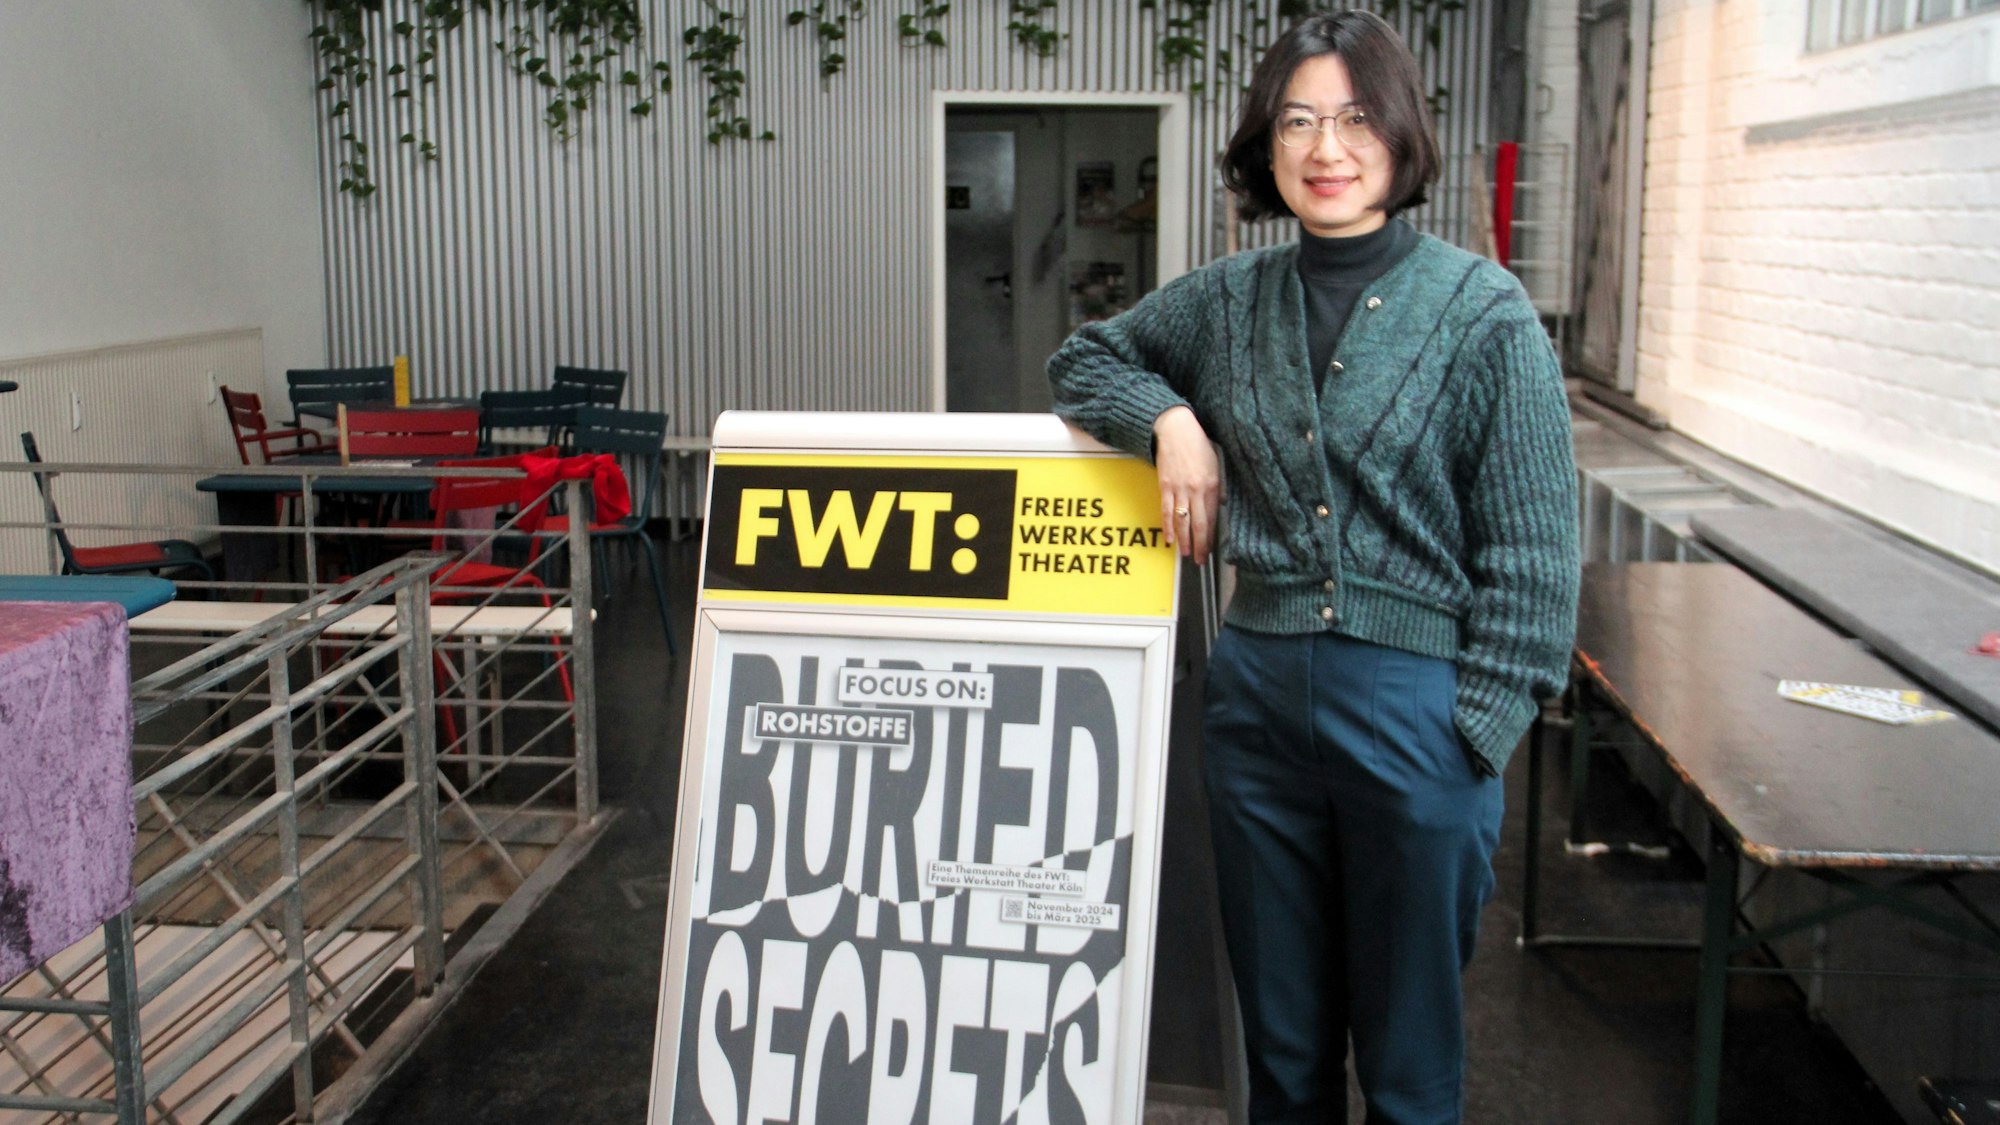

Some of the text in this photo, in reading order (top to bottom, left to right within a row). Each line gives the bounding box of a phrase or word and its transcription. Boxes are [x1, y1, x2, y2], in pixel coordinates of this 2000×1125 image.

[1021, 497, 1104, 518] FREIES
[735, 488, 981, 575] FWT:
[1019, 525, 1171, 548] WERKSTAT
[1018, 552, 1131, 575] THEATER
[845, 675, 986, 701] FOCUS ON:
[762, 710, 906, 740] ROHSTOFFE
[931, 873, 1083, 893] Freies Werkstatt Theater Köln
[932, 863, 1071, 882] Eine Themenreihe des FWT:
[1026, 911, 1102, 925] bis März 2025
[1027, 902, 1114, 916] November 2024
